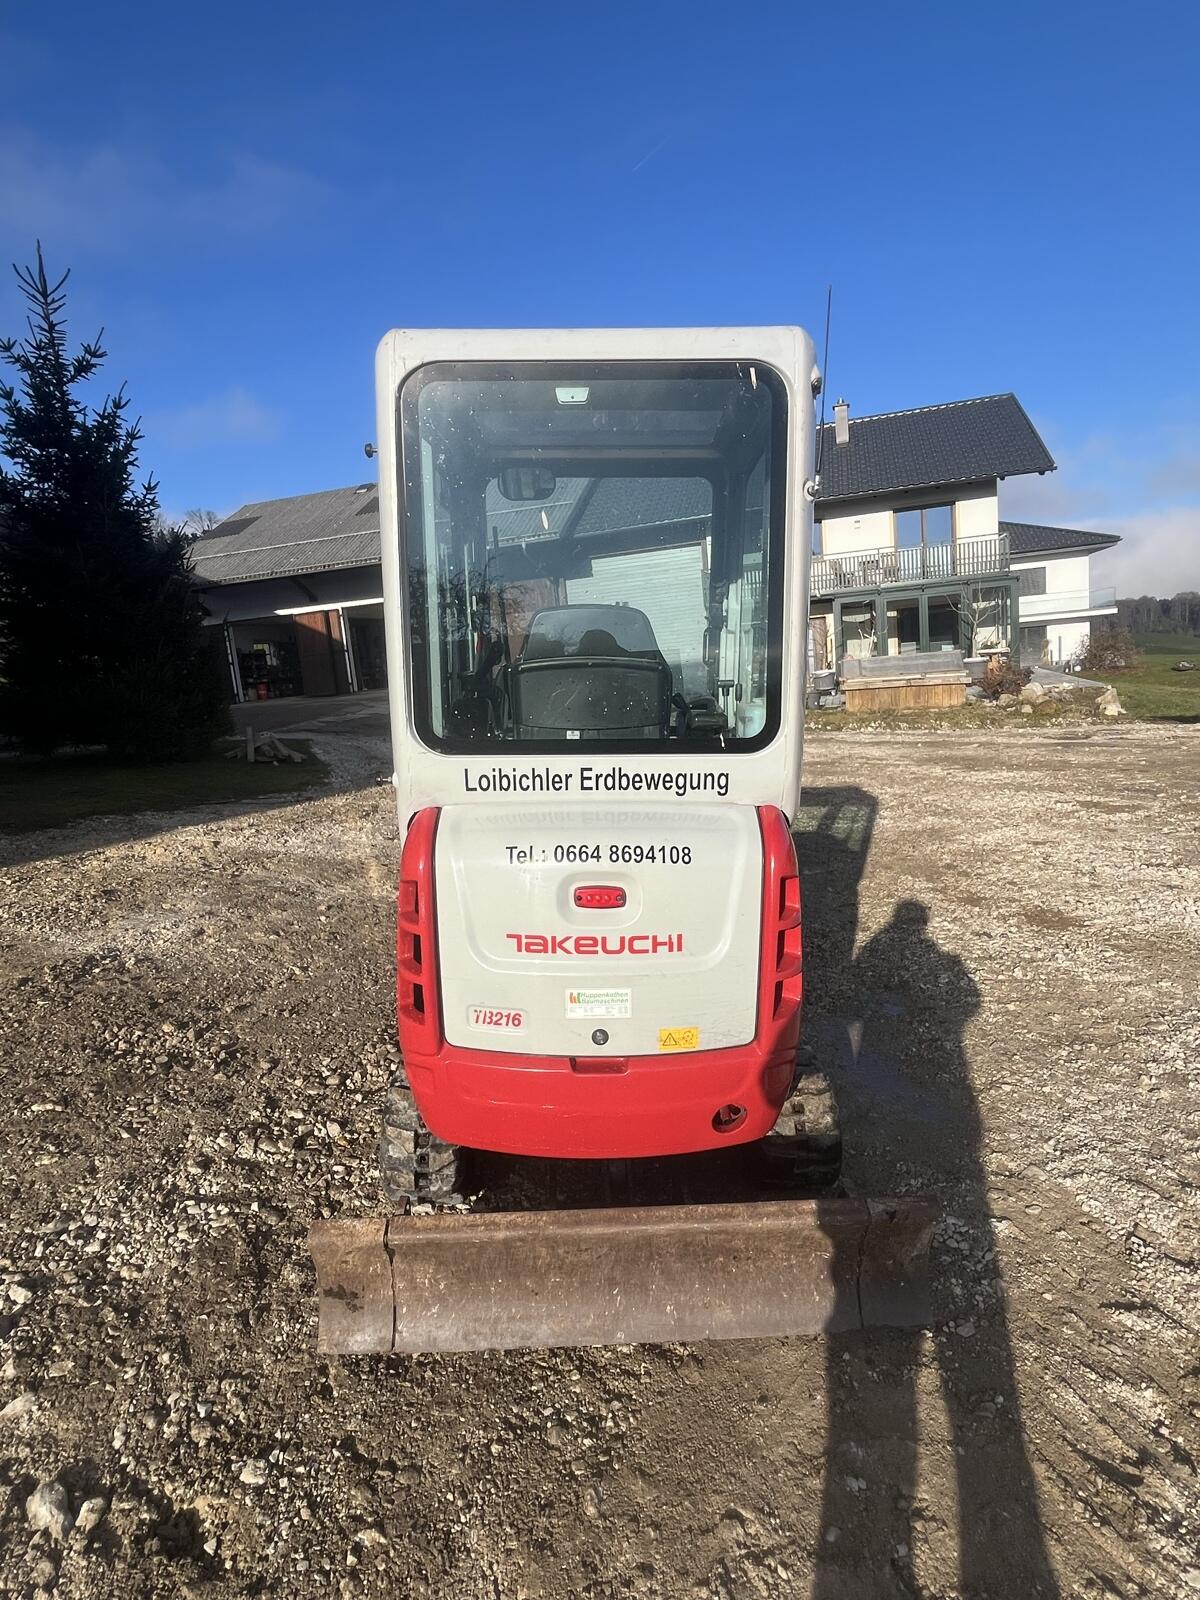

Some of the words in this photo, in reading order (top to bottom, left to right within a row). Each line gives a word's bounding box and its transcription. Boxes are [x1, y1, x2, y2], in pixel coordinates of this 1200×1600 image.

[464, 768, 573, 792] Loibichler
[580, 767, 730, 796] Erdbewegung
[553, 844, 602, 864] 0664
[609, 844, 693, 864] 8694108
[506, 933, 683, 955] TAKEUCHI
